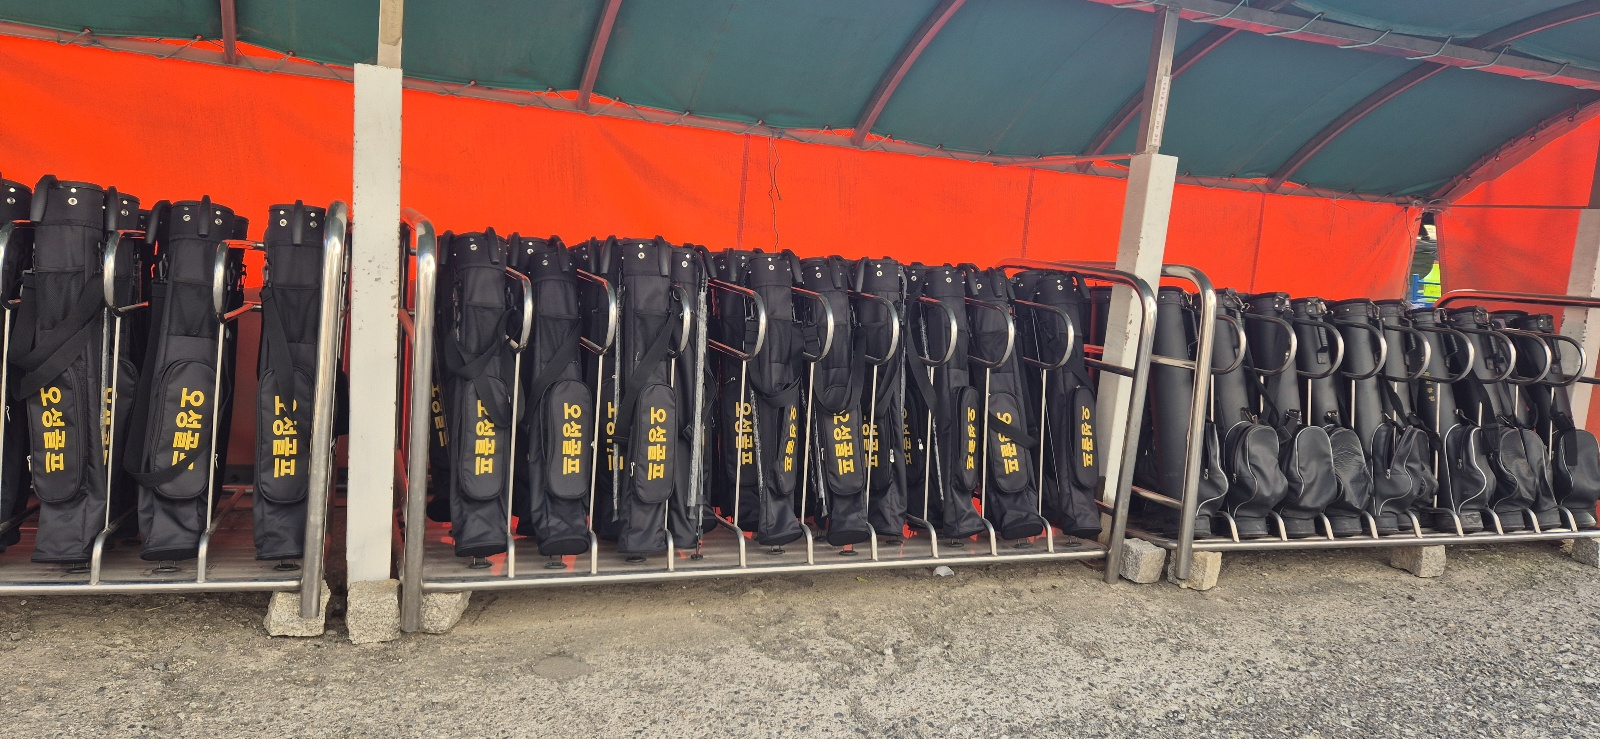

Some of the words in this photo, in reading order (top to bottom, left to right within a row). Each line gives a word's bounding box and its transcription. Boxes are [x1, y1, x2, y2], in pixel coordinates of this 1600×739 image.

[40, 387, 66, 474] 오성골프
[561, 403, 583, 475] 오성골프
[646, 407, 668, 481] 오성골프
[784, 404, 797, 473] 오성골프
[862, 416, 879, 468] 성골프
[966, 406, 976, 470] 오성골프
[1080, 406, 1094, 468] 오성골프
